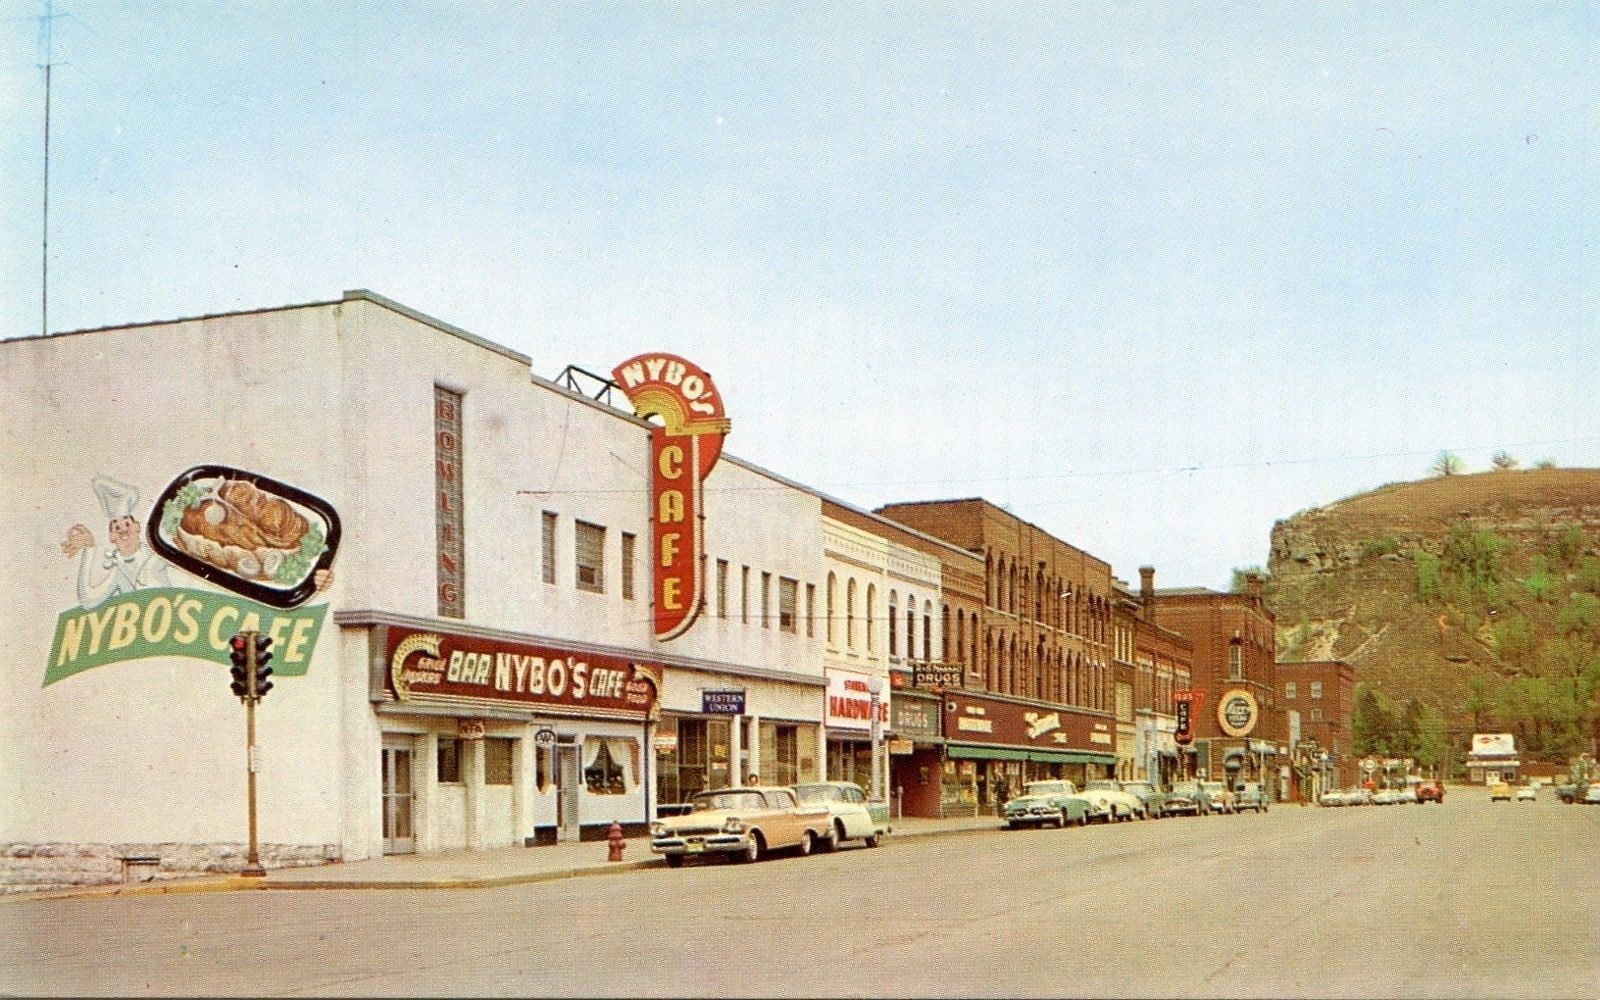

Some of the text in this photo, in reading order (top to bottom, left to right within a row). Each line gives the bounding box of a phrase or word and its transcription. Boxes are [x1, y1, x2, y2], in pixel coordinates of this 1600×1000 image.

[621, 358, 715, 416] NYBO'S
[437, 400, 457, 605] BOWLING
[658, 445, 684, 610] CAFE
[56, 593, 204, 667] NYBO'S
[447, 650, 627, 699] BAR NYBO'S CAFE
[704, 694, 744, 702] WESTERN
[917, 673, 961, 683] DRUGS
[829, 695, 889, 722] HARDWE
[898, 710, 929, 729] DRUGS
